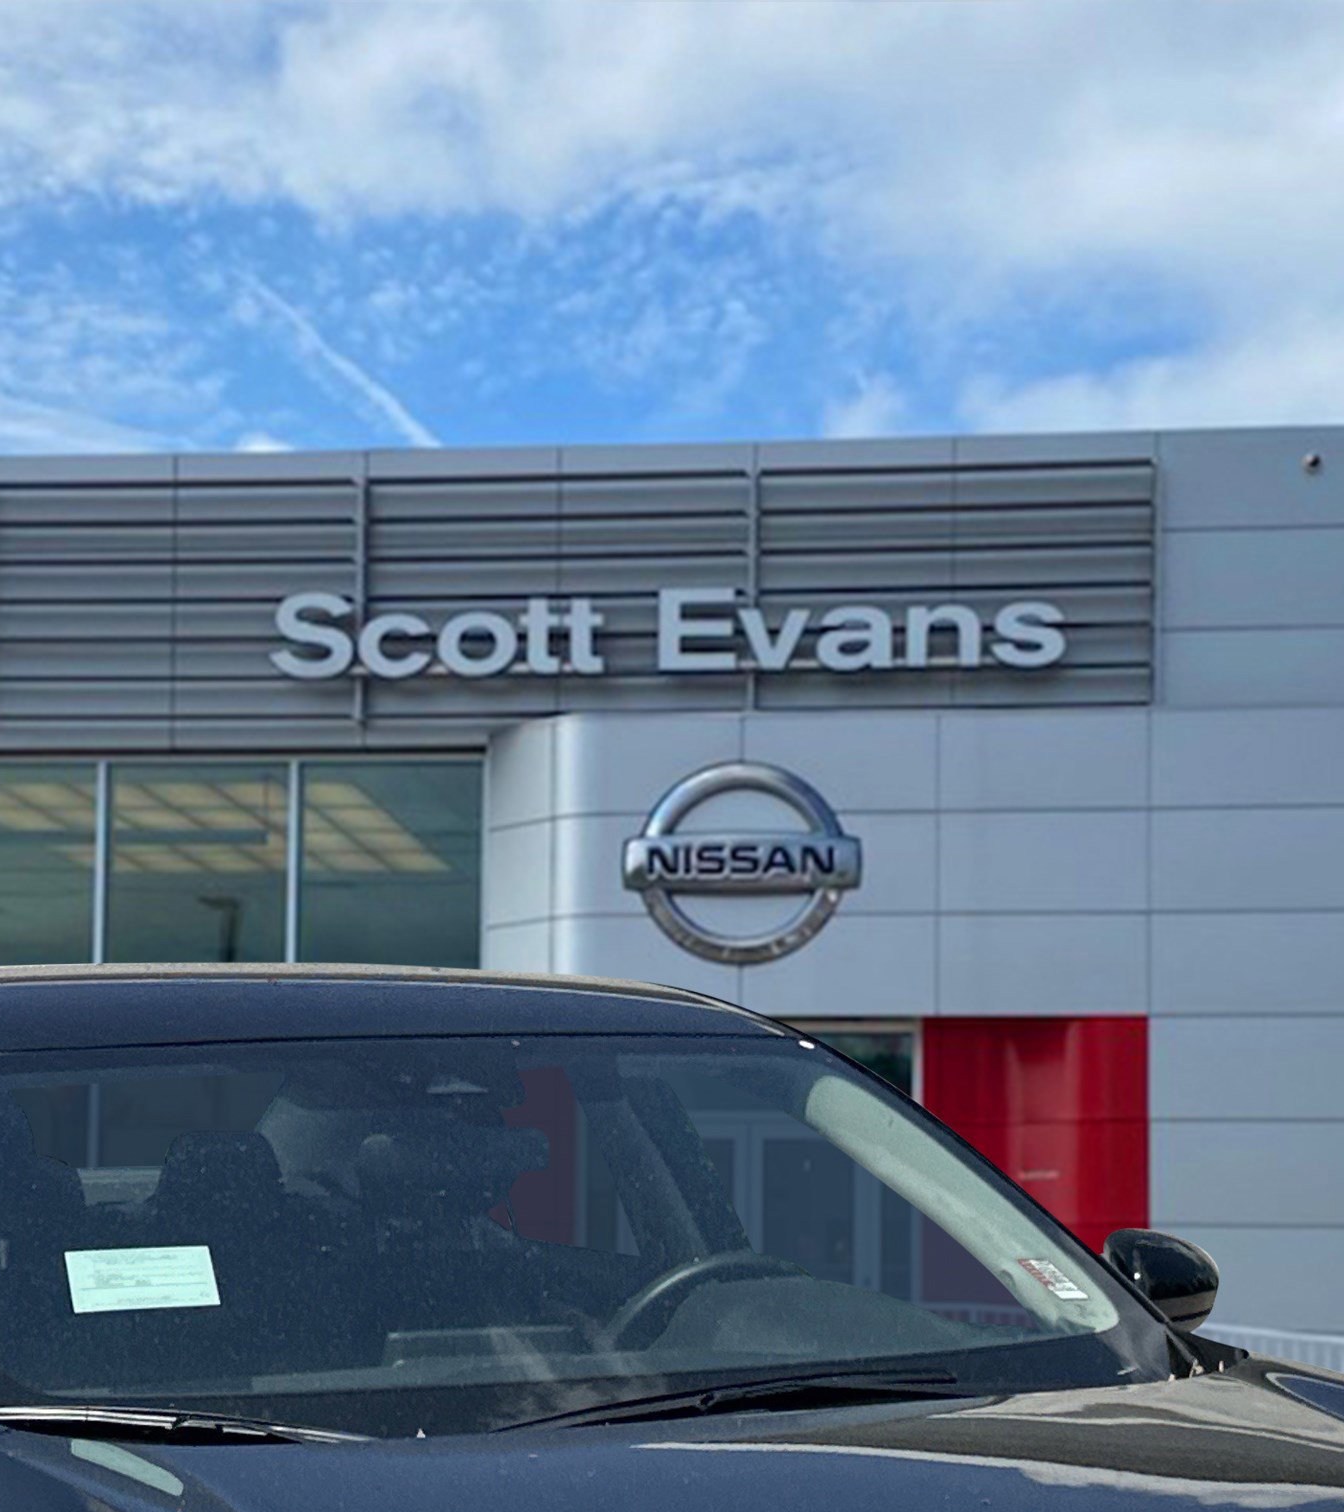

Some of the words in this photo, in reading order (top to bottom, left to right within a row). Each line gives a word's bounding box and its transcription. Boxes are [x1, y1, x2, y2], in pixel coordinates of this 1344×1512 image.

[269, 592, 605, 680] Scott
[657, 587, 1067, 673] Evans
[646, 845, 835, 876] NISSAN
